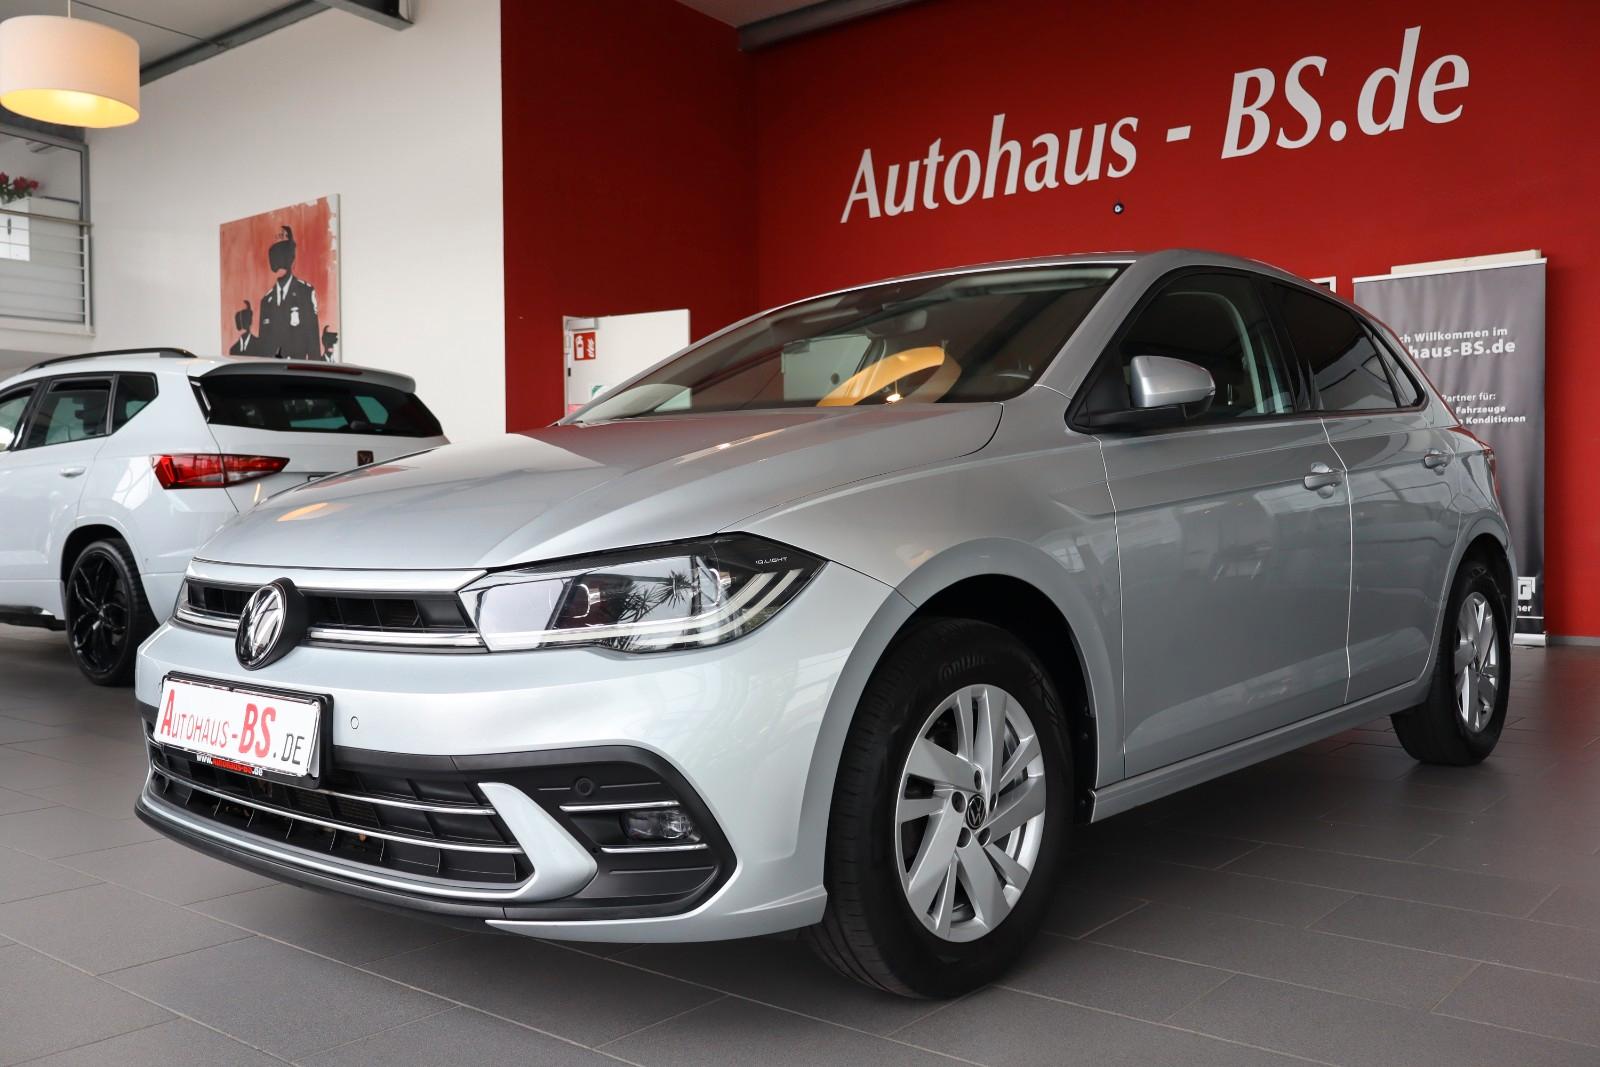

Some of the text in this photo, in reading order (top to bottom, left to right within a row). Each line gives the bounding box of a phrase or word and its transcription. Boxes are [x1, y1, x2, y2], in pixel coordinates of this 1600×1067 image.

[840, 25, 1470, 224] Autohaus - BS.de
[1414, 329, 1489, 342] Willkommen
[1492, 327, 1508, 337] im
[1408, 339, 1516, 359] haus-BS.de
[1479, 391, 1496, 401] für:
[1455, 405, 1506, 415] Fahrzeuge
[1465, 415, 1527, 425] Konditionen
